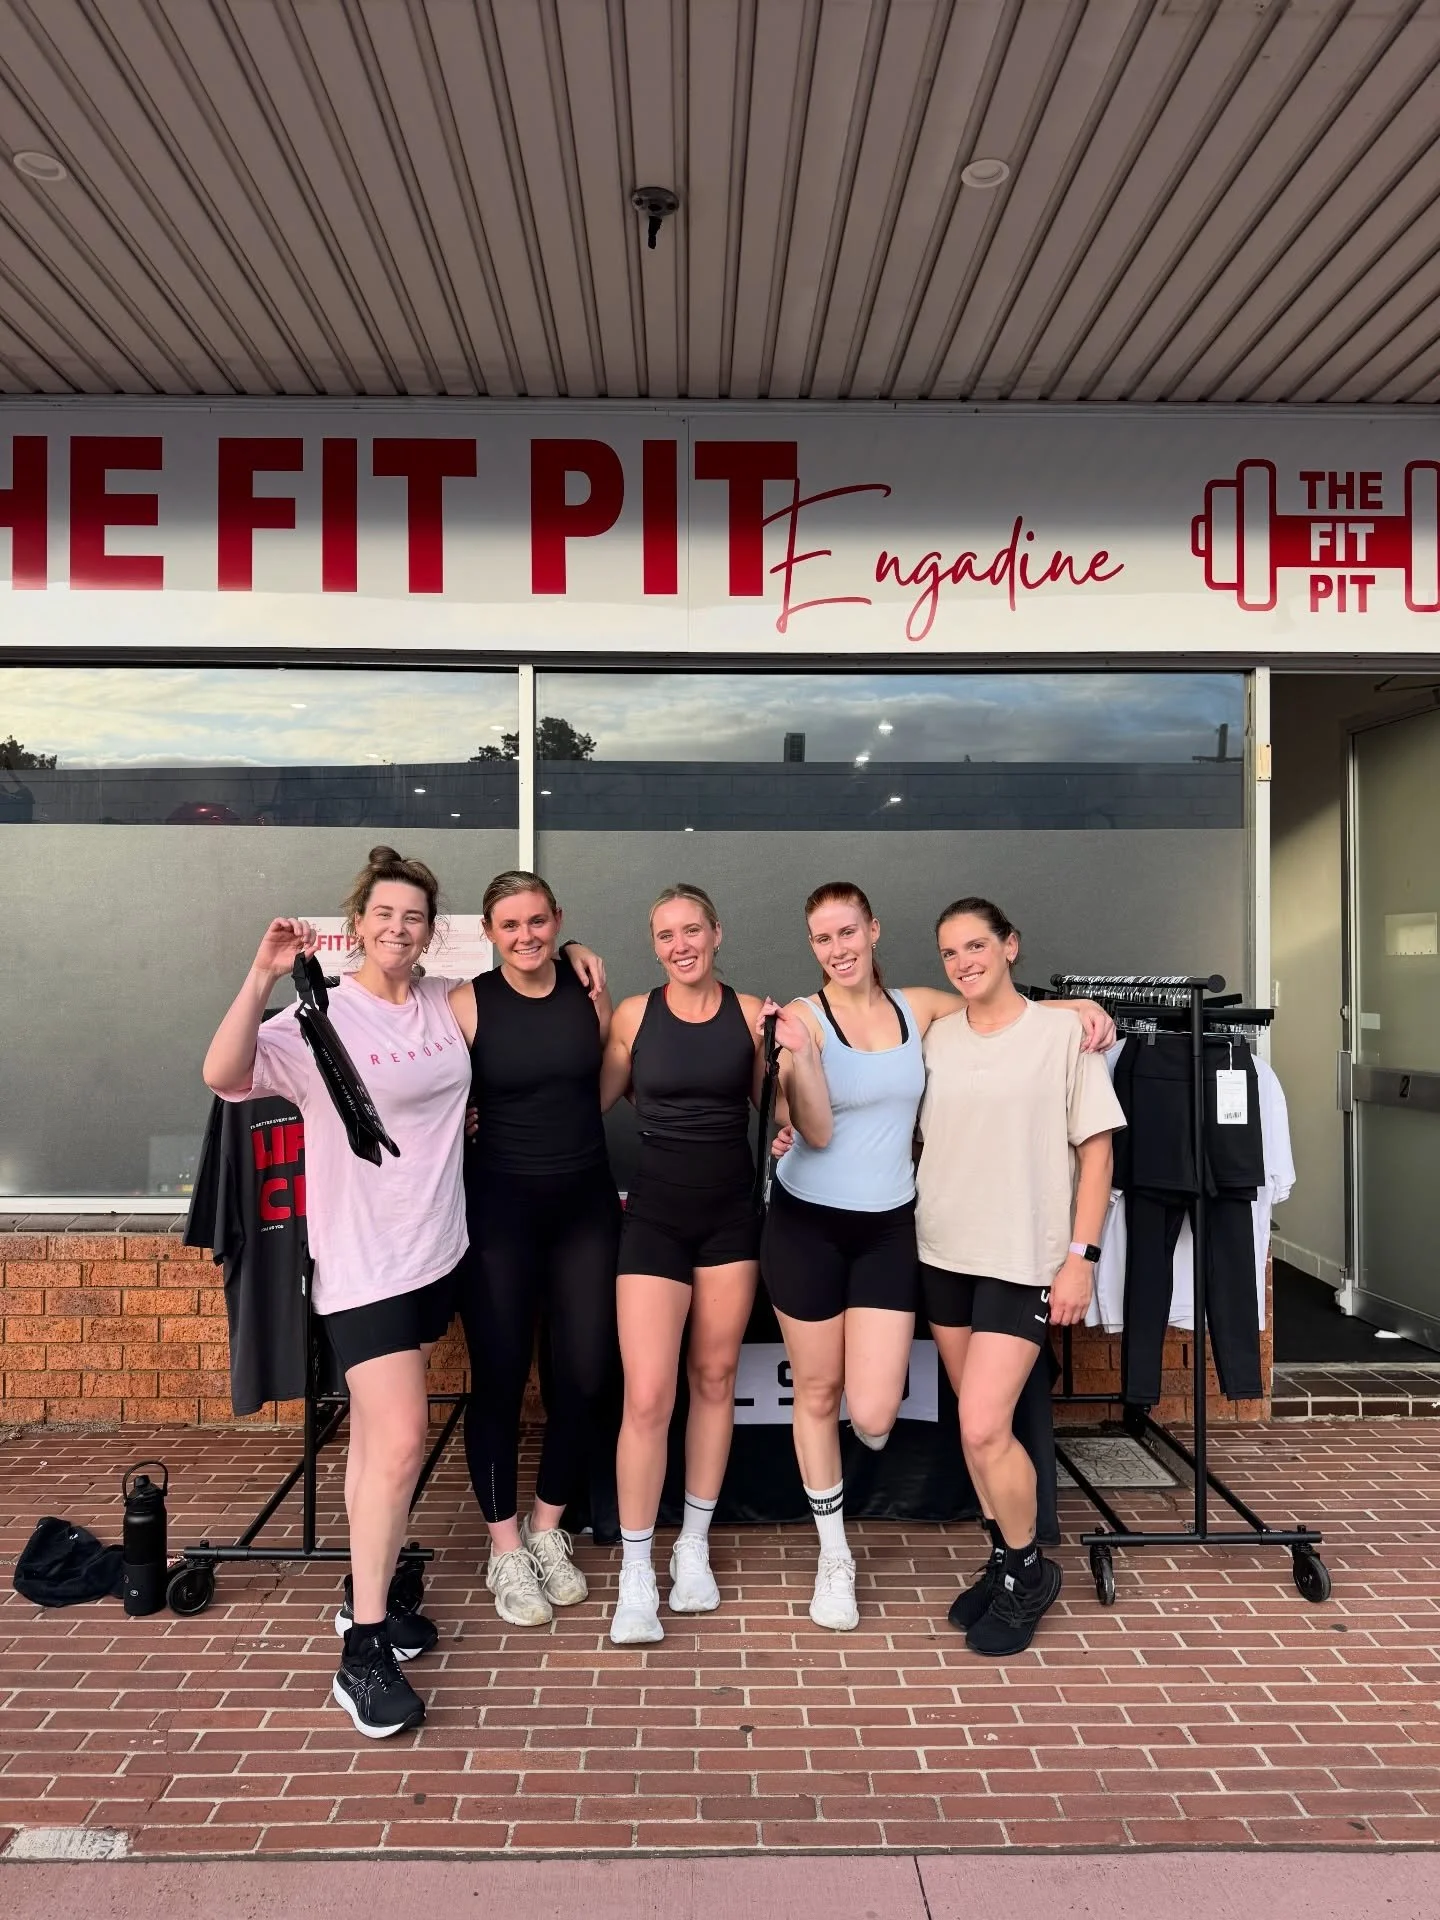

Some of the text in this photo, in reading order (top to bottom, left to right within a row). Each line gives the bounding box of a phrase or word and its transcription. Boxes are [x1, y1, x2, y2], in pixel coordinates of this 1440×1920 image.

[1299, 471, 1383, 510] THE
[217, 437, 478, 594] FIT
[530, 439, 798, 596] PIT
[761, 477, 1125, 642] Engadine
[1310, 522, 1375, 562] FIT
[1309, 574, 1376, 613] PIT
[317, 935, 345, 951] FIT
[1399, 1075, 1411, 1098] 2
